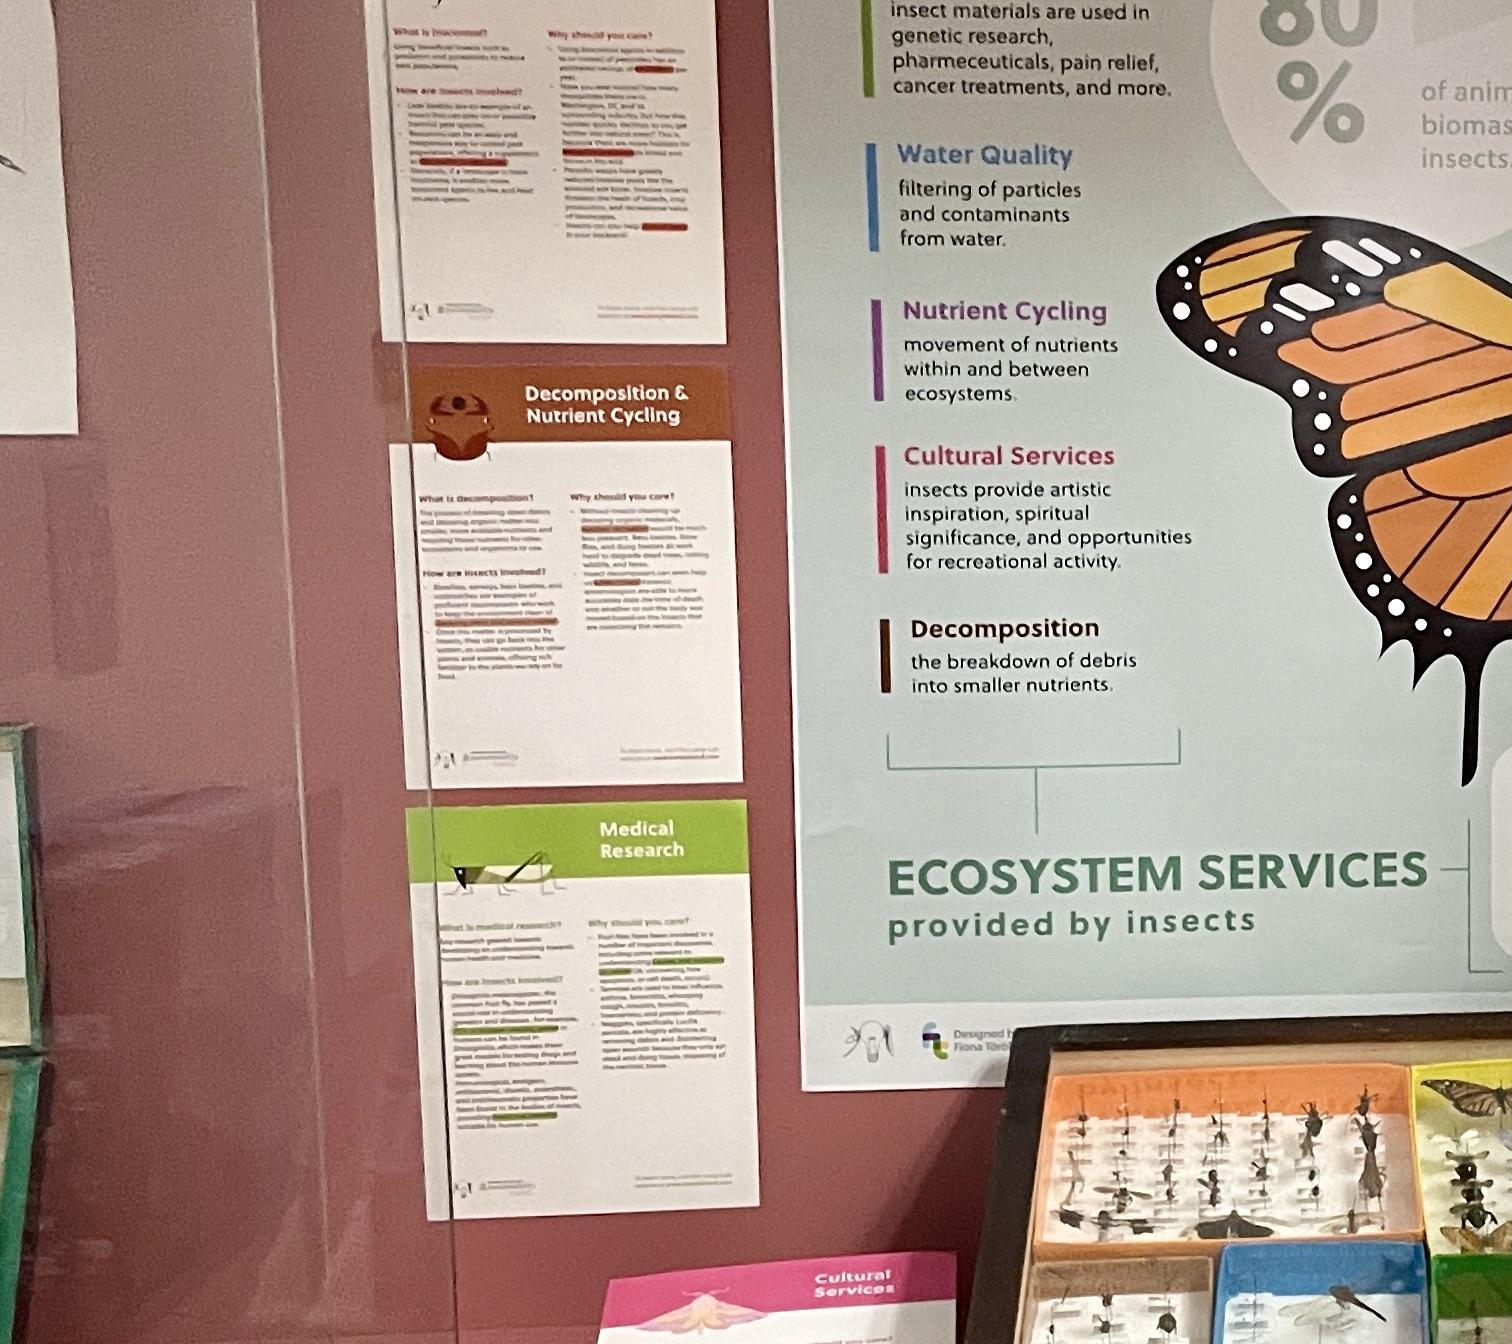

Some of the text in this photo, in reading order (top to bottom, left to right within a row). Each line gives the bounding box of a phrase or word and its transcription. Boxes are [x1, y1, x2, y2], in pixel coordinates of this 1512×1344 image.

[891, 1, 1149, 20] insect materials are used in
[891, 28, 1052, 47] genetic research,
[893, 52, 1158, 75] pharmeceuticals, pain relief,
[893, 78, 1171, 97] cancer treatments, and more.
[1422, 80, 1446, 101] of
[1276, 61, 1364, 143] %
[897, 144, 1072, 170] Water Quality
[899, 179, 1080, 201] filtering of particles
[900, 205, 1069, 222] and contaminants
[900, 229, 1005, 246] from water.
[904, 301, 1106, 326] Nutrient Cycling
[904, 335, 1117, 353] movement of nutrients
[904, 360, 1088, 377] within and between
[525, 385, 688, 405] Decomposition &
[905, 388, 1016, 404] ecosystems.
[527, 407, 679, 426] Nutrient Cycling
[904, 445, 1114, 465] Cultural Services
[905, 482, 1110, 501] insects provide artistic
[905, 505, 1088, 525] inspiration, spiritual
[906, 529, 1191, 549] significance, and opportunities
[907, 553, 1119, 571] for recreational activity.
[912, 618, 1098, 643] Decomposition
[911, 652, 1136, 670] the breakdown of debris
[913, 677, 1112, 693] into smaller nutrients.
[600, 820, 673, 836] Medical
[600, 842, 683, 858] Research
[889, 852, 1426, 895] ECOSYSTEM SERVICES
[889, 910, 1253, 945] provided by insects
[815, 1269, 891, 1285] Cultural
[813, 1284, 894, 1299] Services
